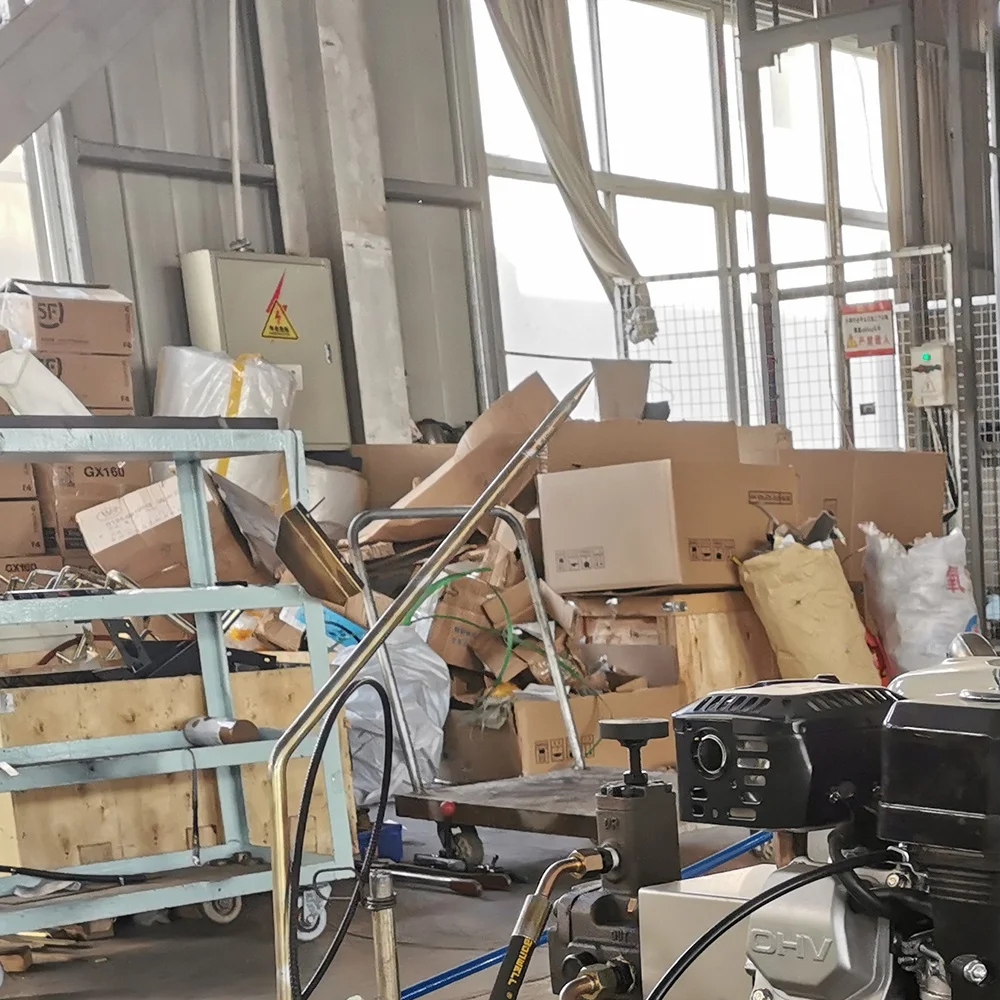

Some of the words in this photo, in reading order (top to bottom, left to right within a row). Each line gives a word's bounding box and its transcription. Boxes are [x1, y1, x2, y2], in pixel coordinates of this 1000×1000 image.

[84, 466, 125, 478] GX160
[508, 936, 533, 985] BONWELL
[751, 928, 833, 962] OHV
